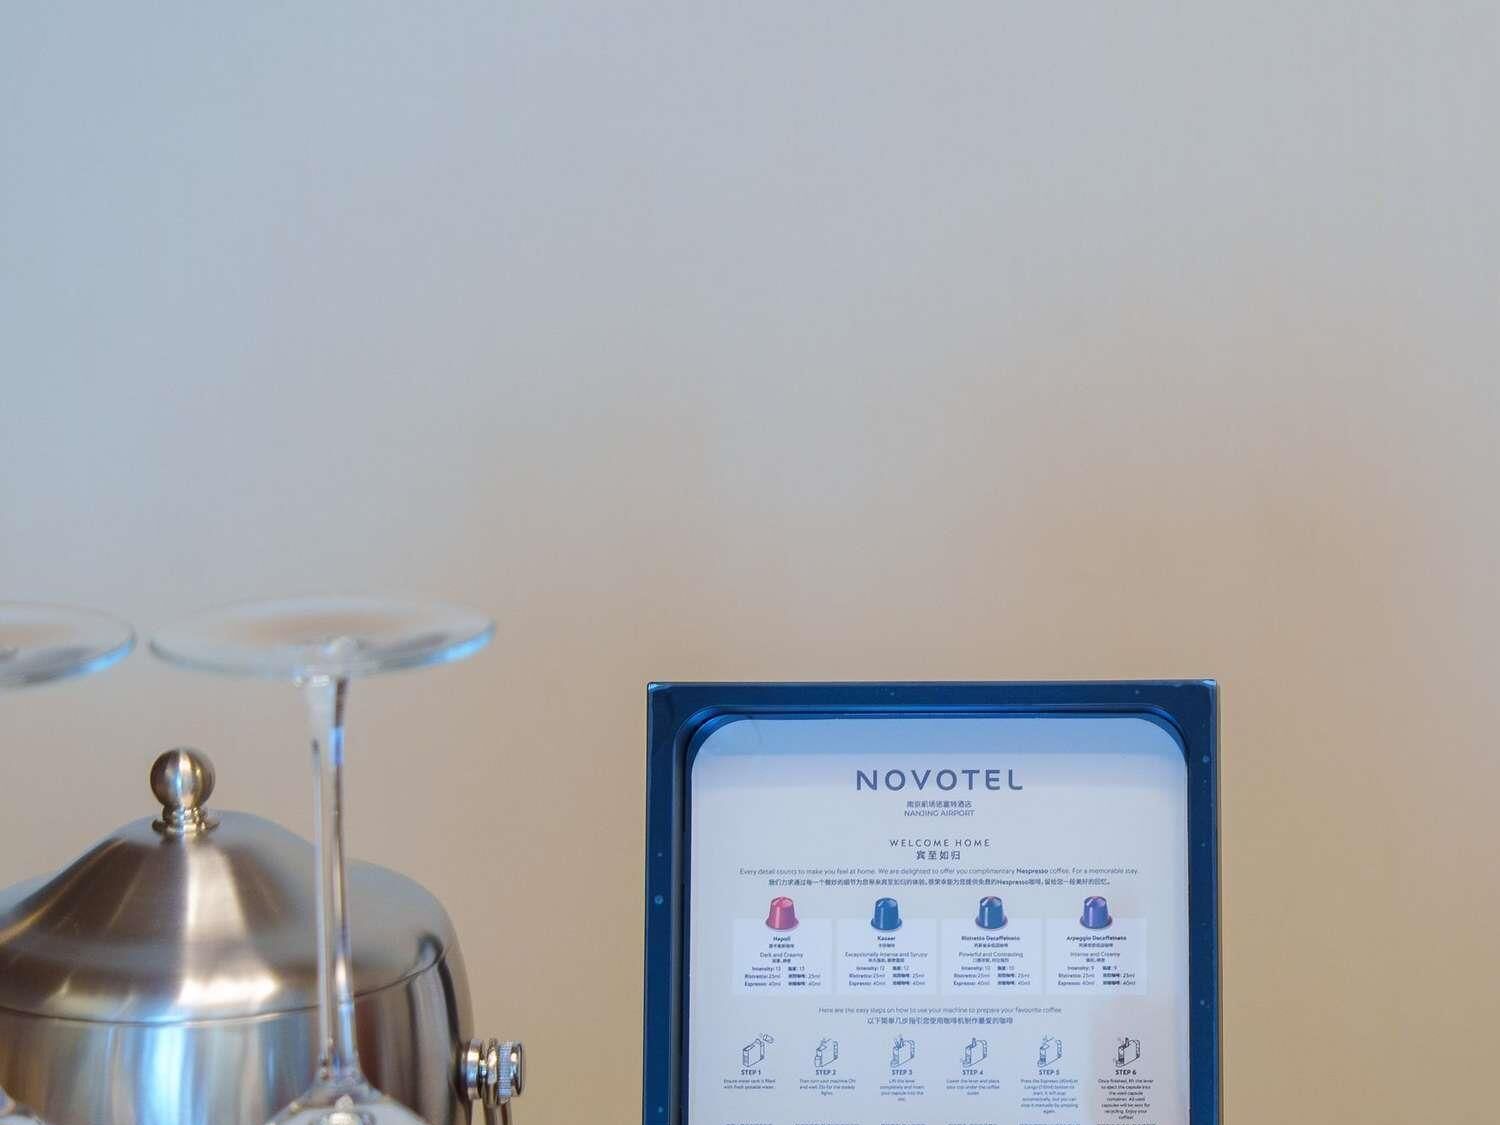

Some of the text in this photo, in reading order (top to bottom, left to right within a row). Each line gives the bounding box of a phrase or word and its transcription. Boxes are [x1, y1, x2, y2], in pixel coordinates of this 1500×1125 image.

[856, 769, 1024, 791] NOVOTEL
[889, 839, 991, 847] WELCOME HOME
[916, 850, 961, 860] 宾至如归
